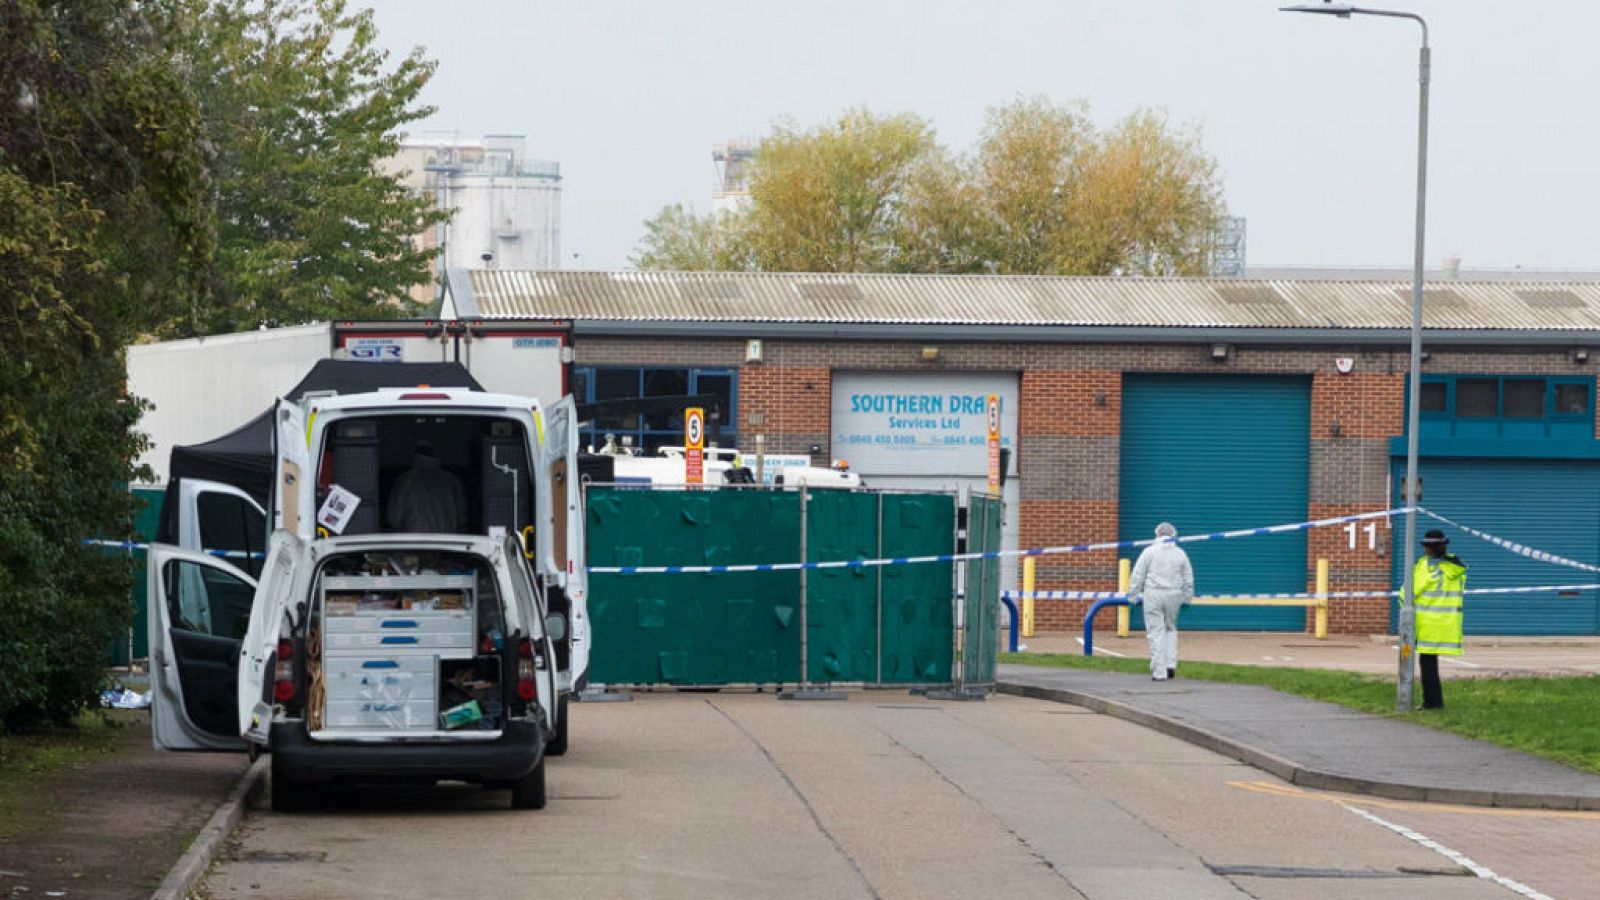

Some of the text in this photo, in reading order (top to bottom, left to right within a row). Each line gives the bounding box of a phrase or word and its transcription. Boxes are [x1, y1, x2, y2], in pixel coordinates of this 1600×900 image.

[351, 344, 401, 357] GTR
[851, 394, 1004, 415] SOUTHERN DRA
[691, 417, 699, 439] 5
[889, 416, 961, 429] Services Ltd
[1343, 521, 1376, 551] 11
